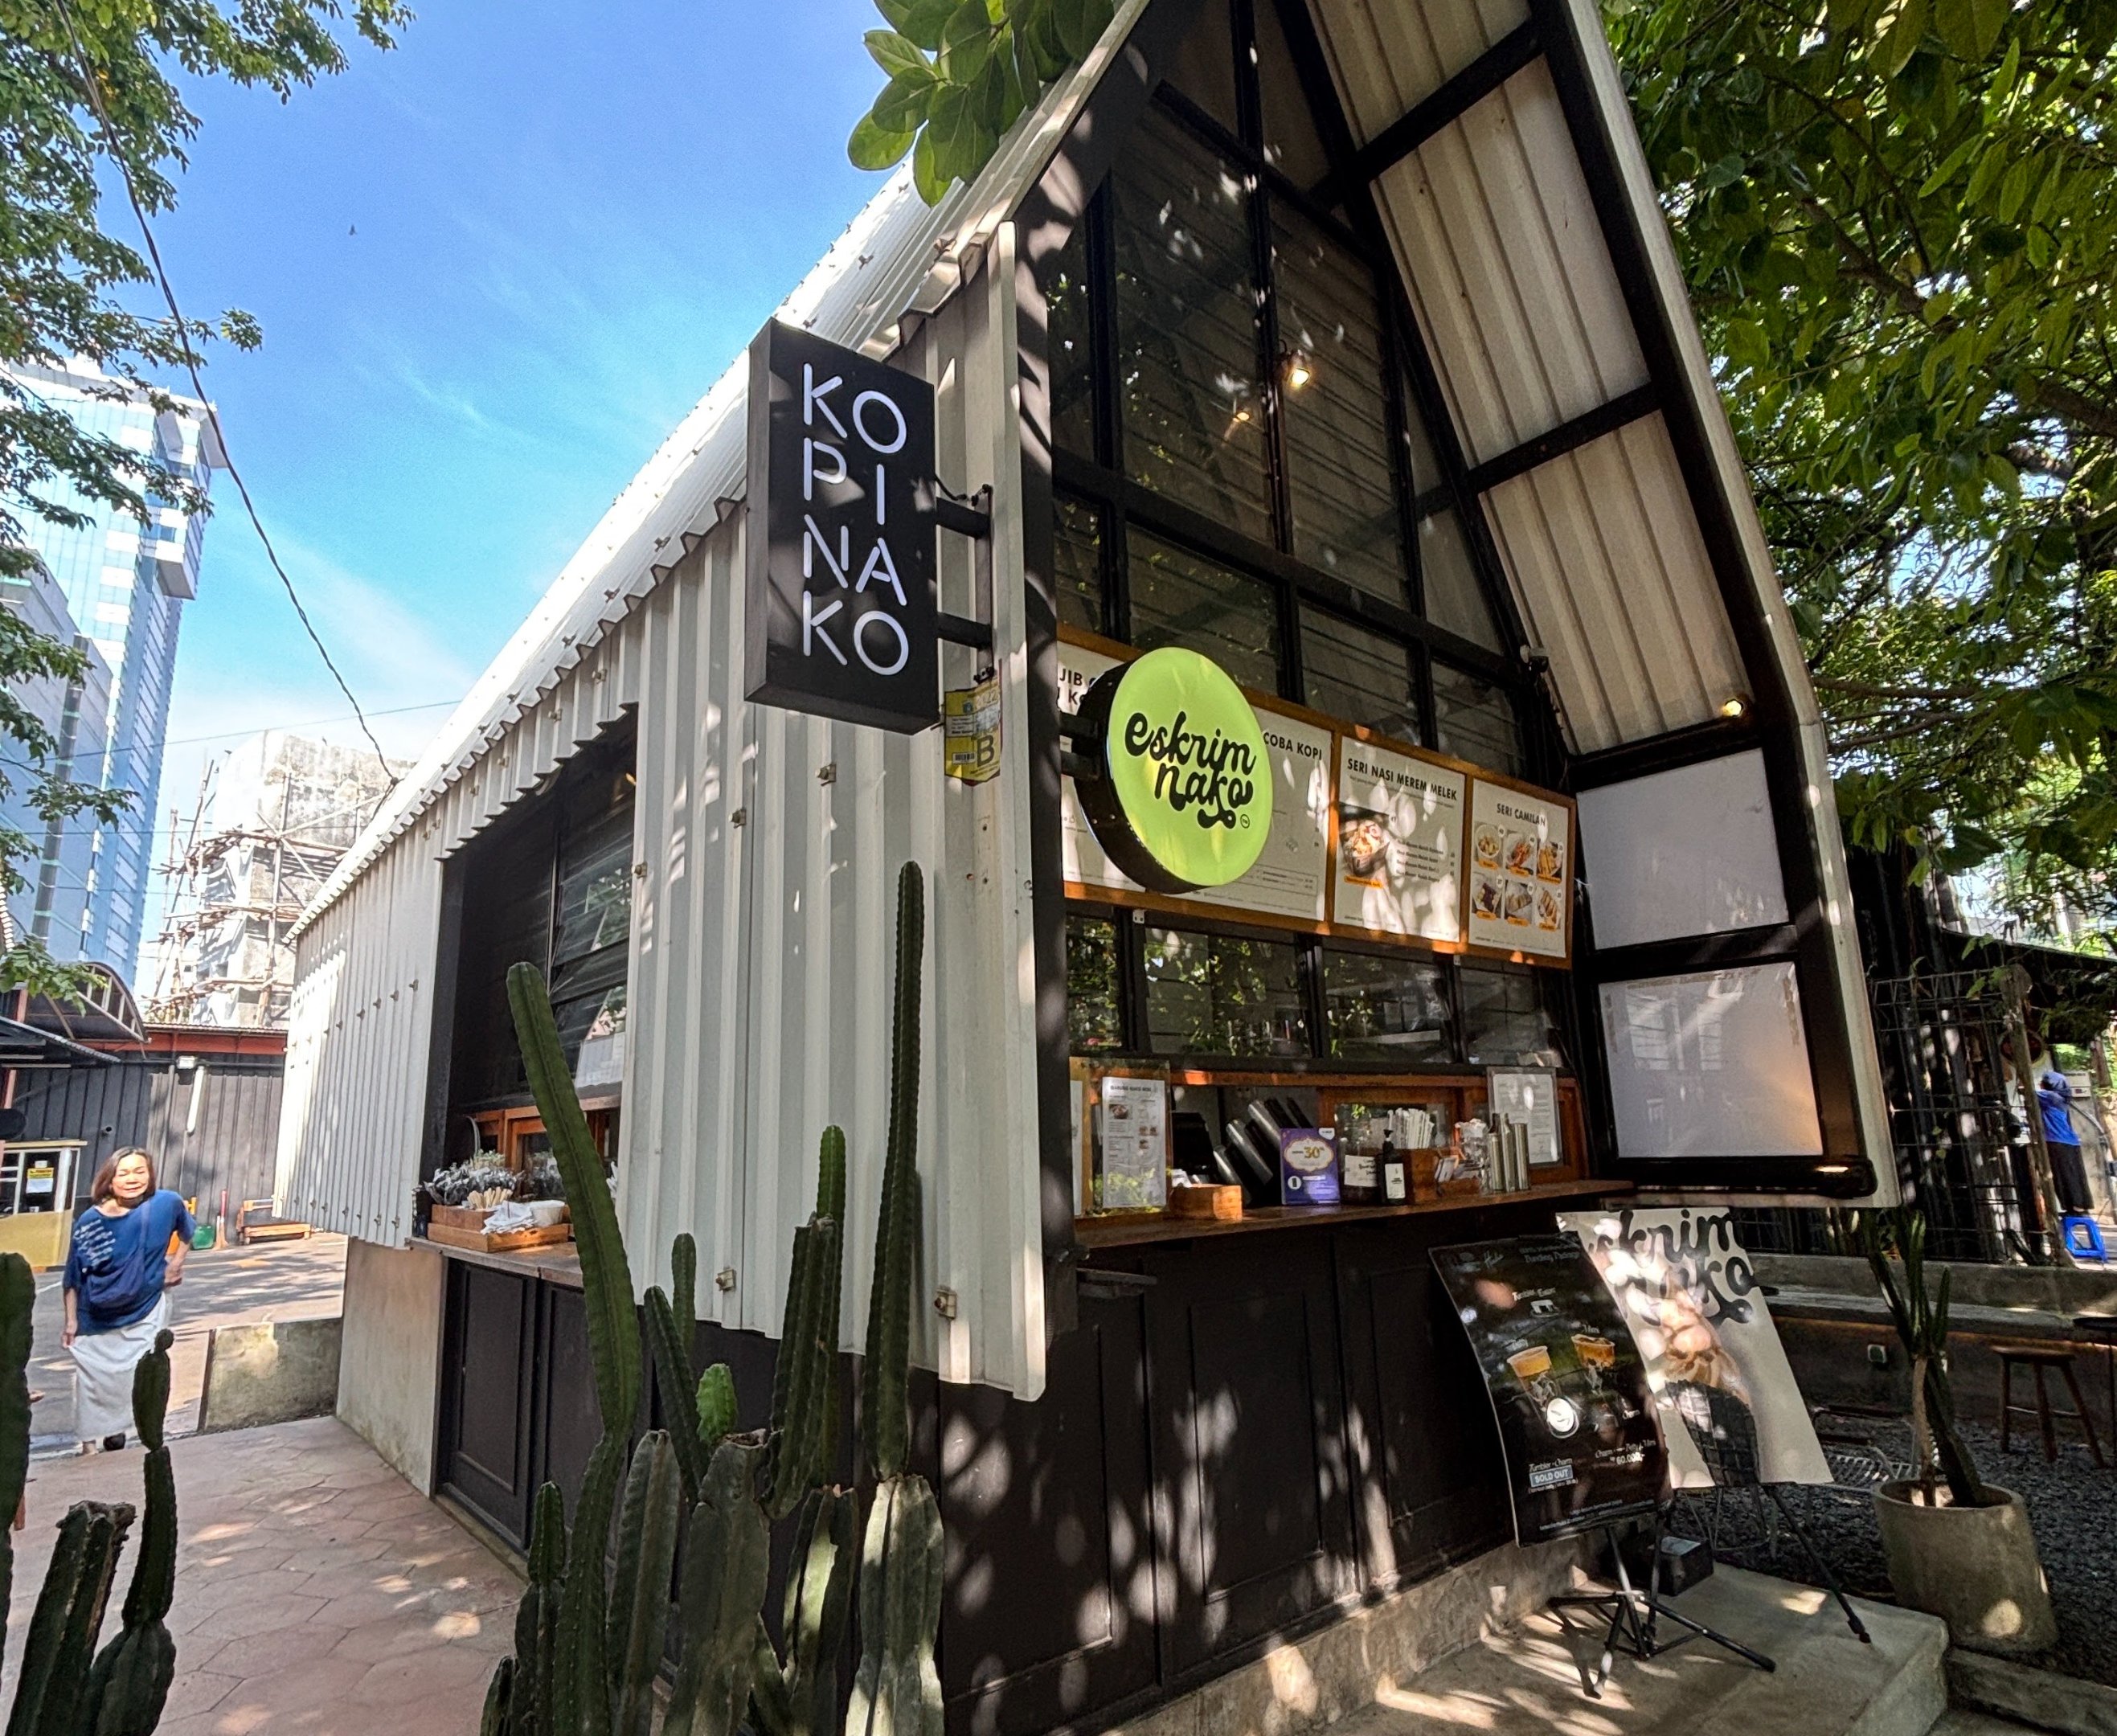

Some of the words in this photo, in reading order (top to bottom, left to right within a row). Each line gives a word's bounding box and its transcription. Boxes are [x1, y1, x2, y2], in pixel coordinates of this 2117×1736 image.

[804, 362, 907, 454] KO
[804, 436, 886, 525] PI
[804, 514, 908, 607] NA
[804, 591, 910, 676] KO
[977, 735, 995, 768] B
[1124, 711, 1257, 776] eskrim
[1263, 731, 1293, 752] COBA
[1297, 741, 1322, 761] KOPI
[1154, 754, 1253, 829] nako
[1347, 758, 1368, 775] SERI
[1371, 764, 1394, 783] NASI
[1397, 772, 1427, 792] MEREM
[1430, 783, 1457, 801] MELEK
[1497, 803, 1513, 817] SERI
[1514, 809, 1546, 827] CAMILAN
[1534, 1472, 1554, 1484] SOLD
[1554, 1468, 1569, 1480] OUT
